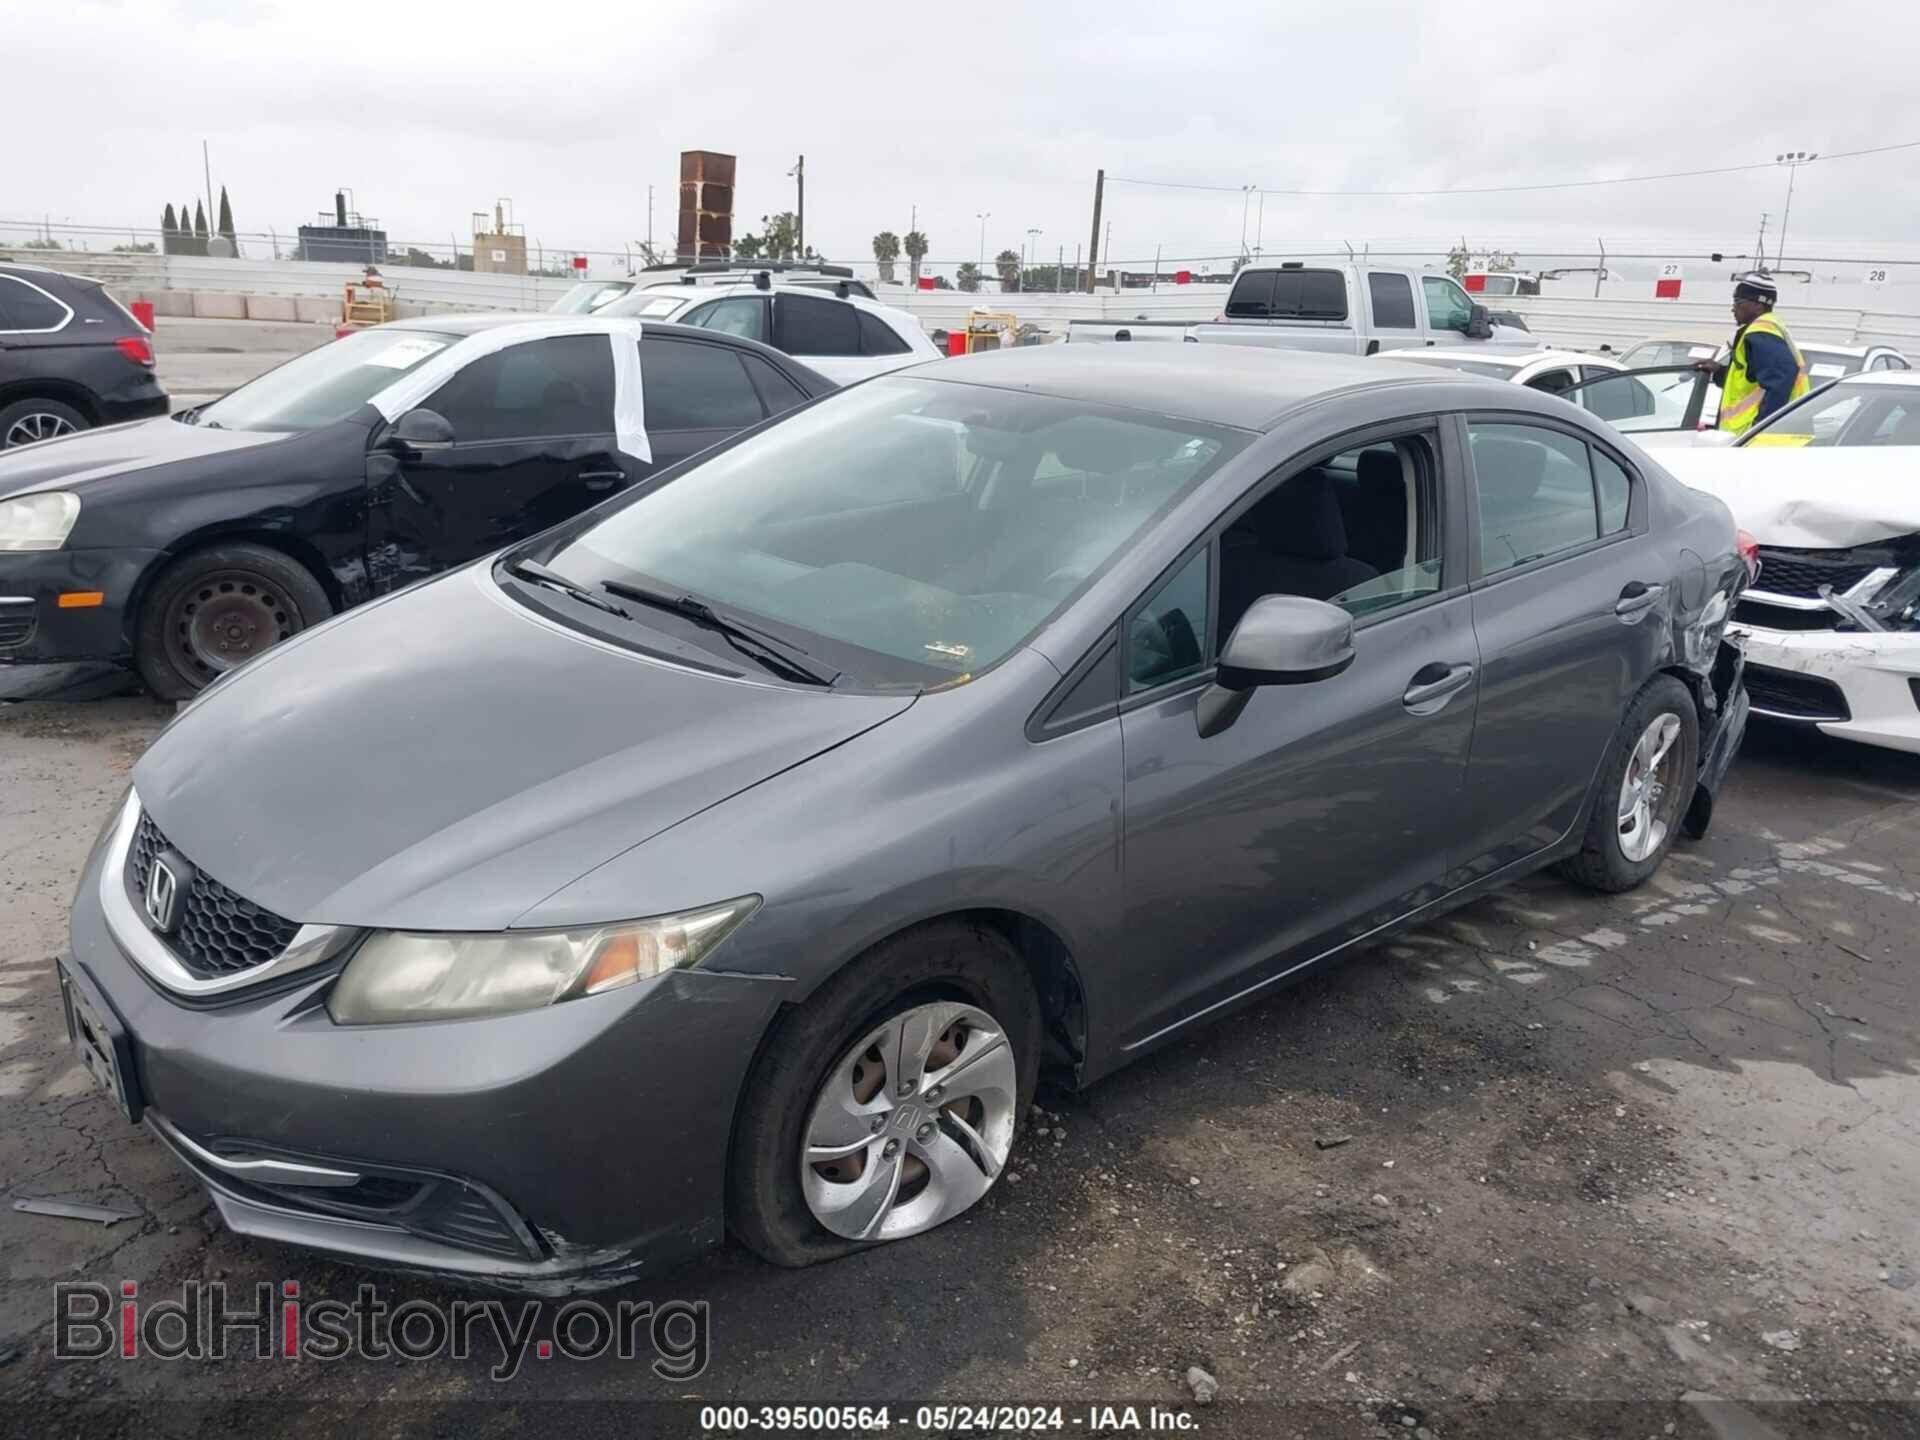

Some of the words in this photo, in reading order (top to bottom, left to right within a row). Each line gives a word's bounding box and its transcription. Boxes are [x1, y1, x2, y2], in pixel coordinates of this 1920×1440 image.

[1473, 261, 1484, 270] 26
[1664, 264, 1678, 275] 27
[1869, 270, 1885, 281] 28
